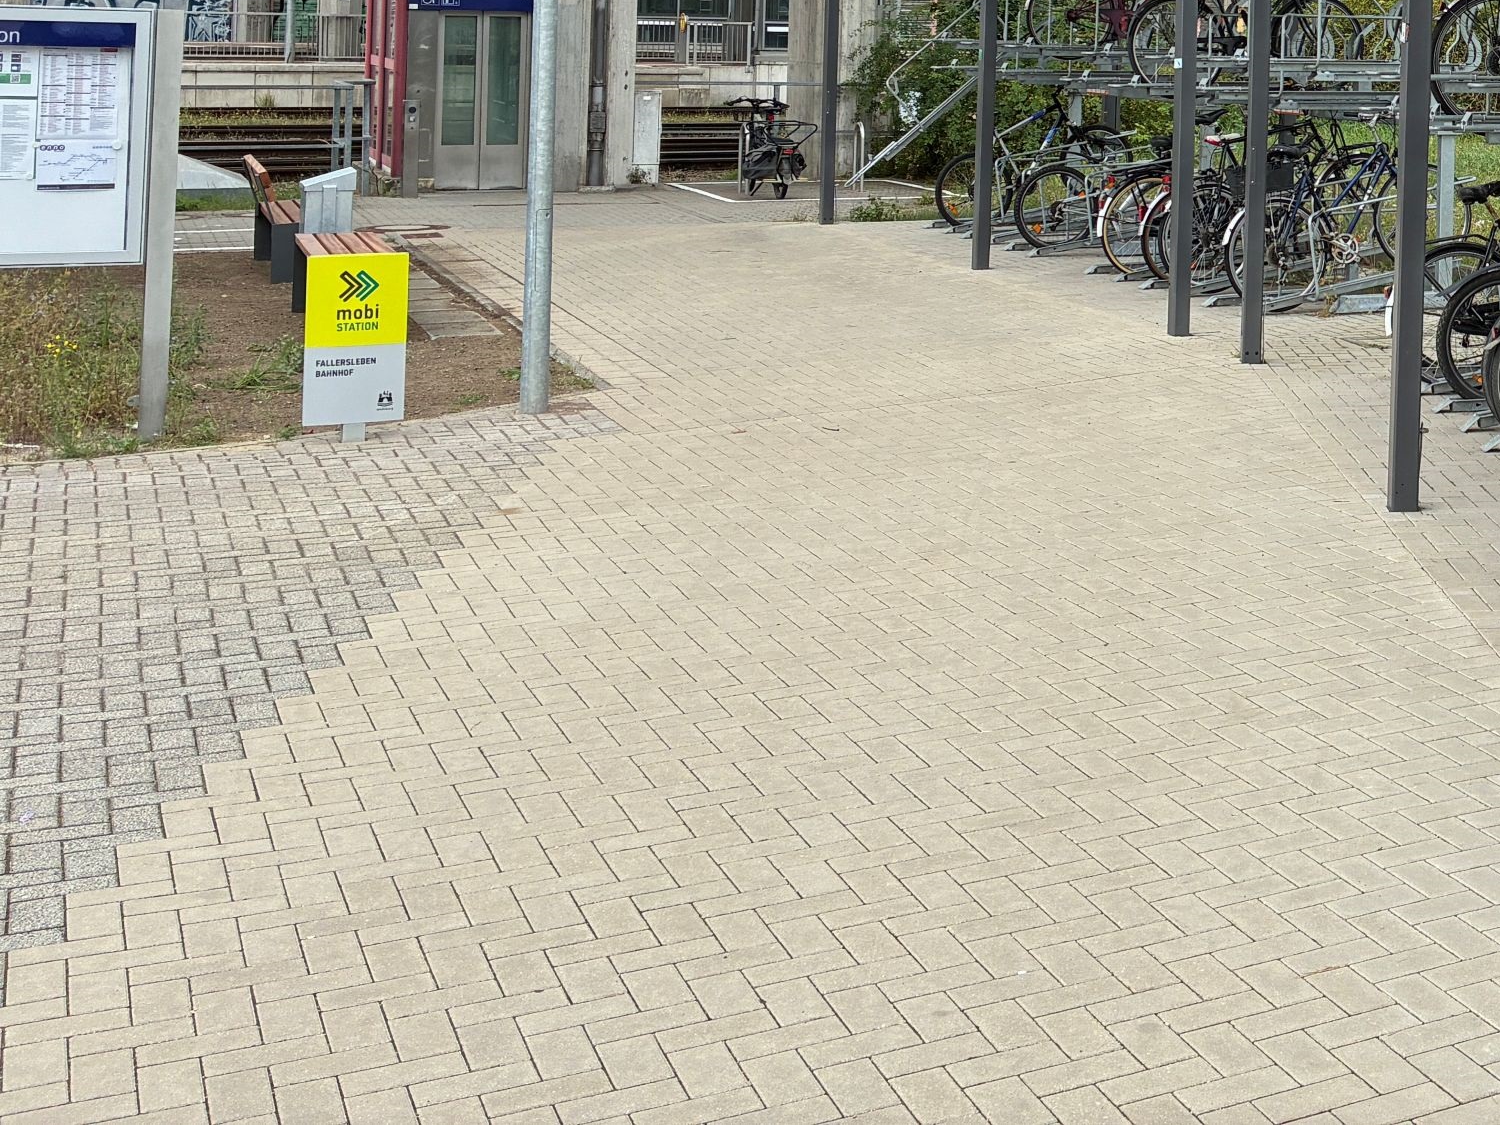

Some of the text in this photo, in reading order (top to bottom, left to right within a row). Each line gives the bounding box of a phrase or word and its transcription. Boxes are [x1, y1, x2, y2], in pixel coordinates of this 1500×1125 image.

[336, 304, 380, 321] mobi
[336, 321, 379, 332] STATION
[315, 357, 377, 368] FALLERSLEBEN
[315, 368, 354, 378] BAHNHOF
